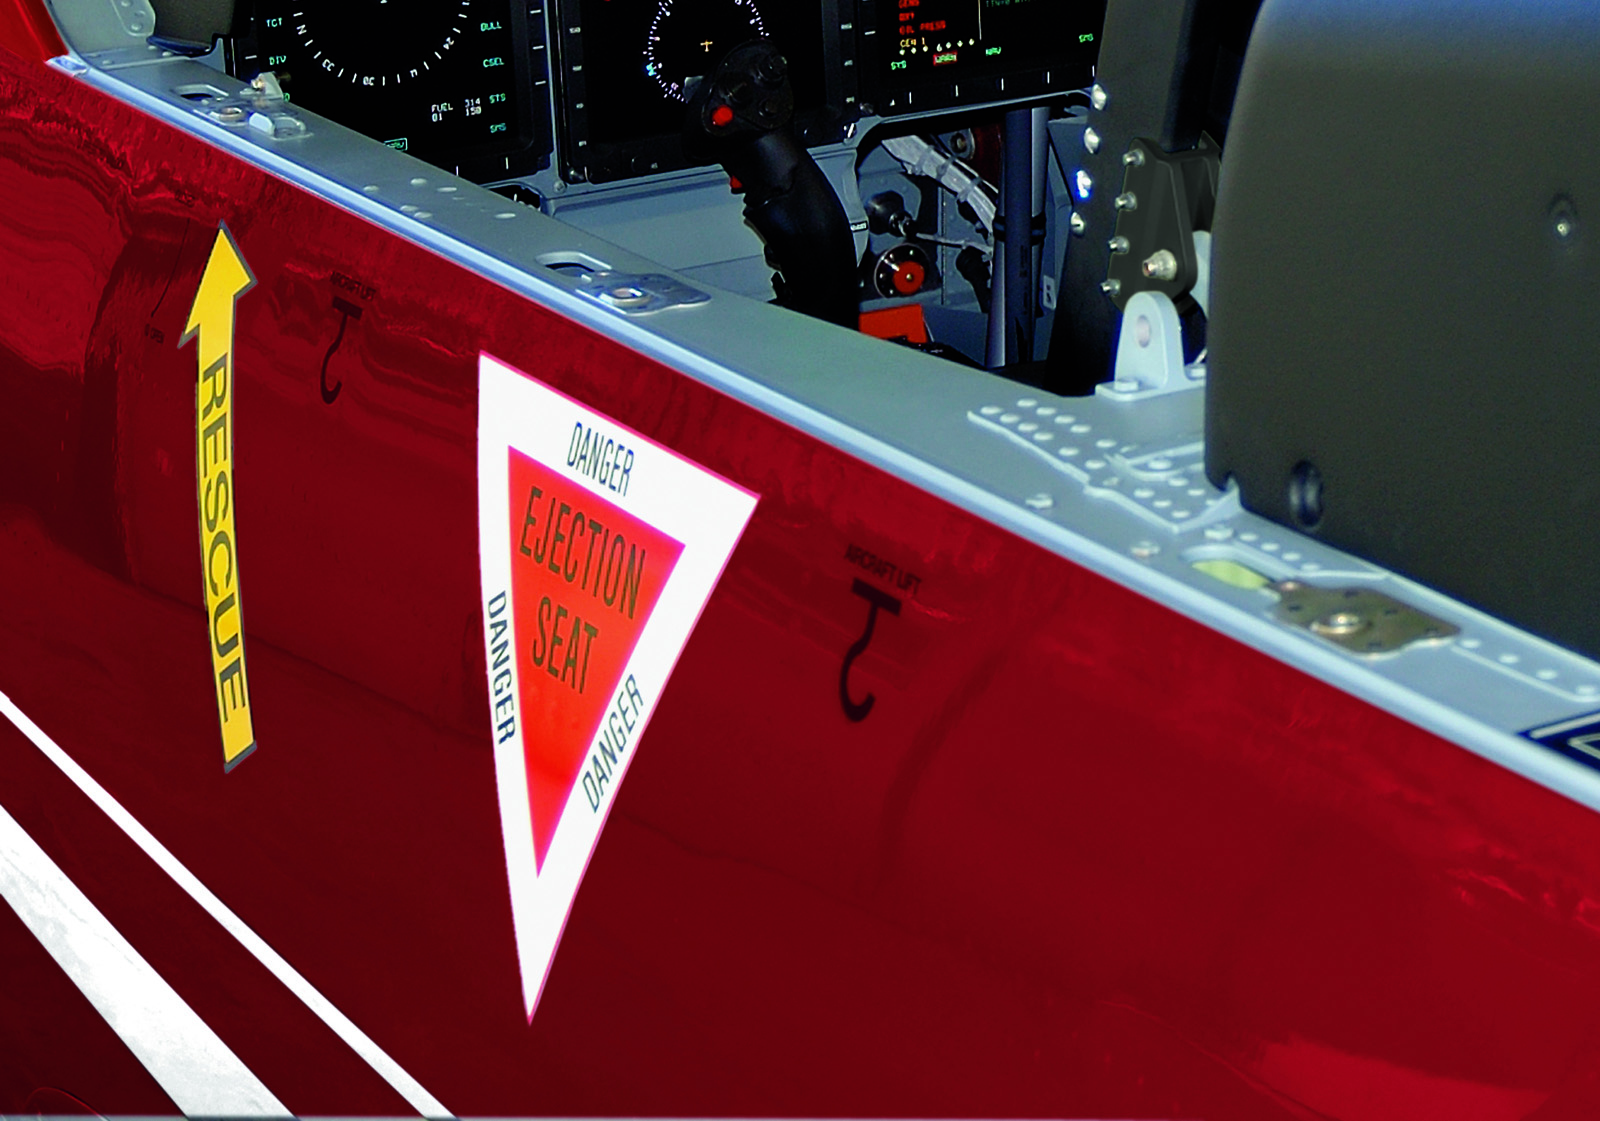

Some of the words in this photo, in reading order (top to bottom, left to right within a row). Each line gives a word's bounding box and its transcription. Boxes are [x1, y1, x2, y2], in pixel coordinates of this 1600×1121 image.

[432, 102, 453, 112] FUEL
[567, 421, 634, 497] DANGER
[202, 352, 247, 723] RESCUE
[519, 485, 646, 620] EJECTION
[488, 591, 516, 745] DANGER
[532, 596, 598, 694] SEAT
[582, 673, 644, 813] DANGER
